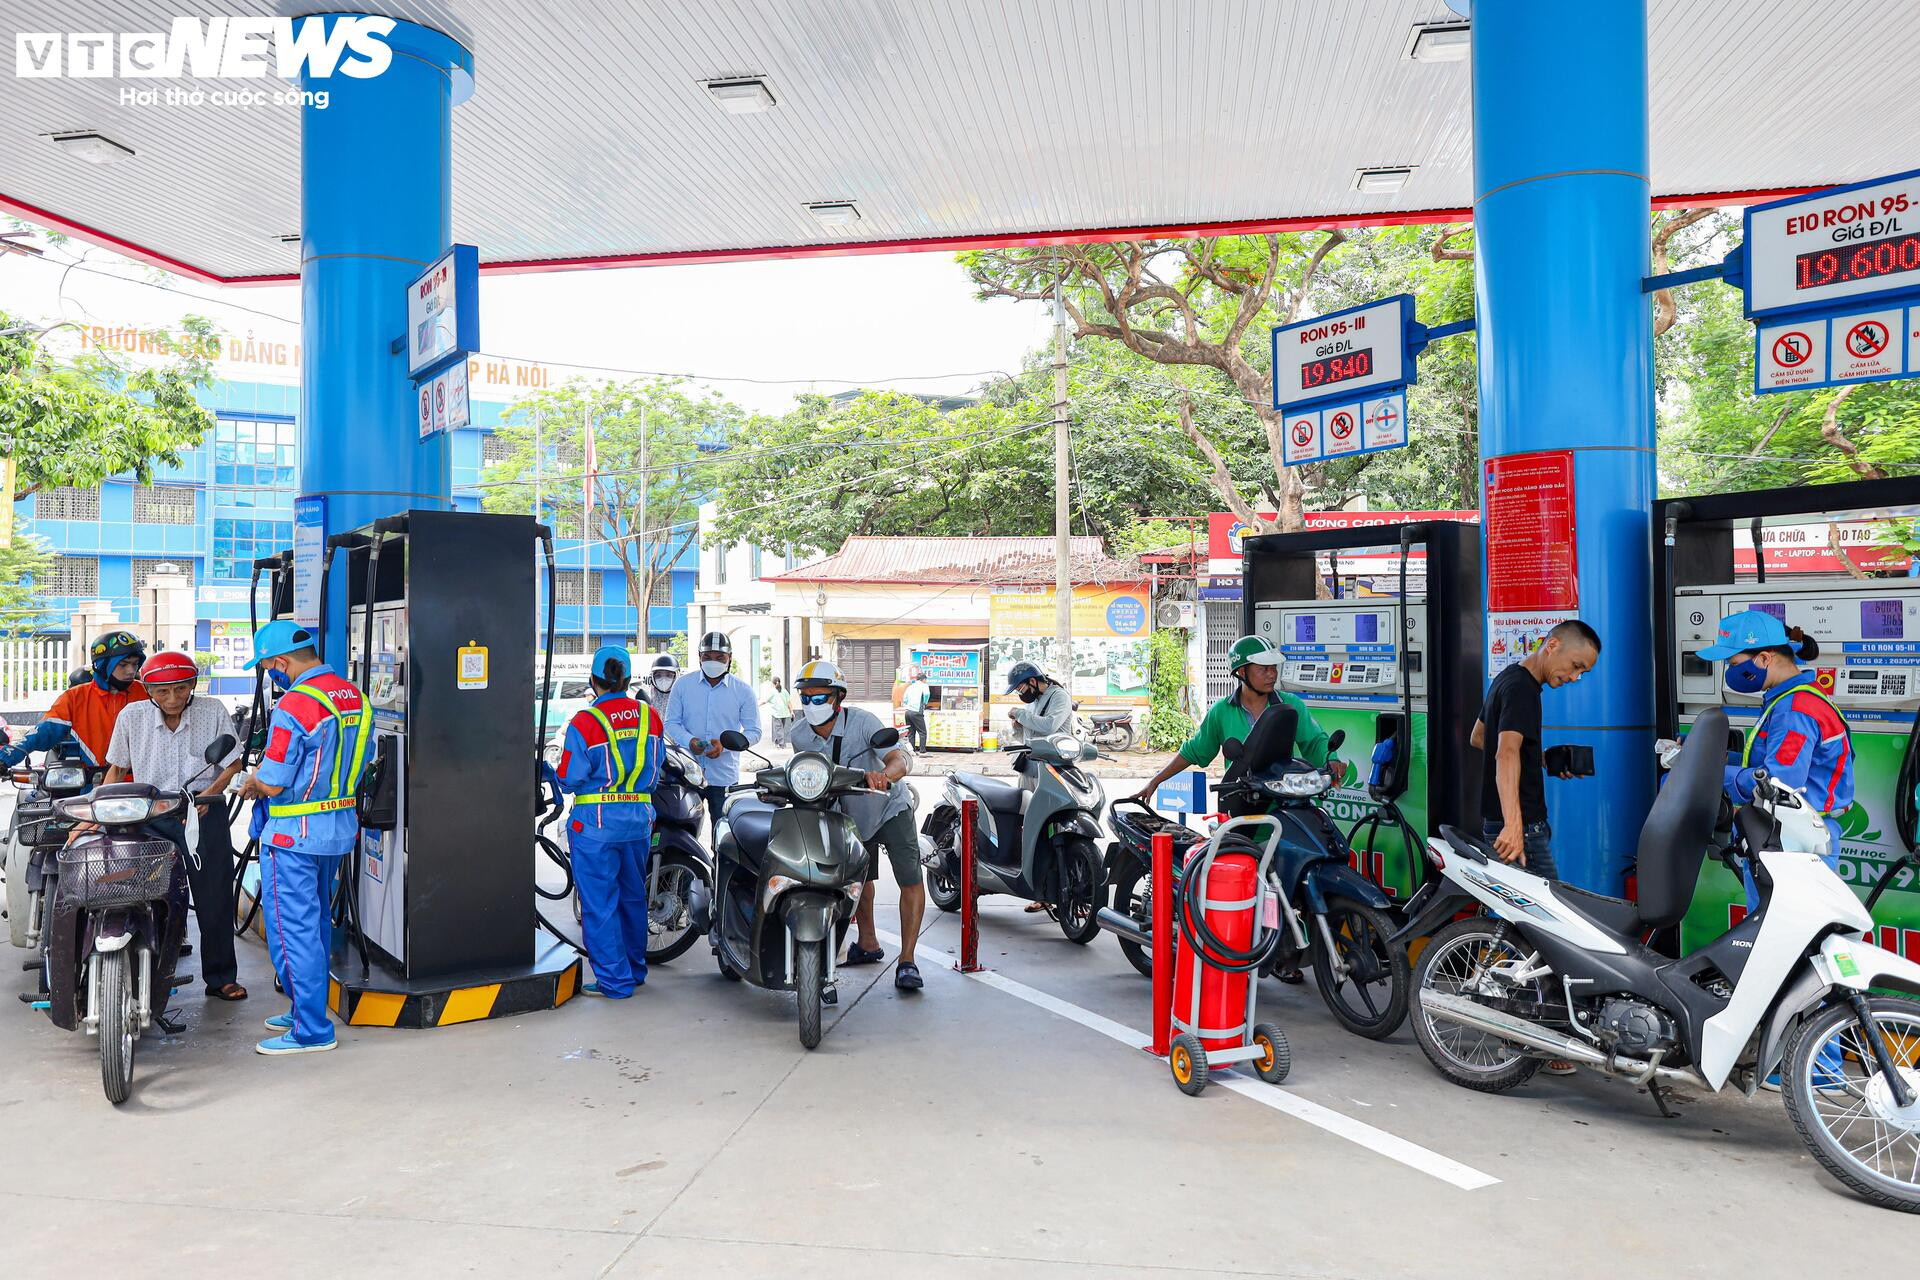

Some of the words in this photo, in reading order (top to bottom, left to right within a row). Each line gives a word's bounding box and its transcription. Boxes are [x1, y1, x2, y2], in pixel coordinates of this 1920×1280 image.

[1786, 212, 1819, 235] E10
[1823, 200, 1875, 228] RON
[1831, 222, 1865, 243] Giá
[1869, 217, 1903, 236] Đ/L
[1797, 237, 1920, 289] 19.600
[1300, 325, 1328, 345] RON
[229, 329, 288, 366] ĐẲNG
[1315, 342, 1334, 358] Giá
[1335, 339, 1353, 353] Đ/L
[487, 359, 510, 385] HÀ
[1302, 353, 1369, 388] 19.840
[1850, 361, 1866, 369] CẤM
[1838, 371, 1855, 379] CẤM
[1869, 367, 1892, 375] THUỐC
[1304, 518, 1348, 528] ƯỜNG
[1762, 530, 1776, 543] ỬA
[1779, 528, 1806, 543] CHỮA
[1852, 530, 1871, 543] TẠO
[1522, 617, 1543, 625] CHỮA
[328, 689, 358, 701] PVOIL
[611, 709, 640, 723] PVOIL
[320, 801, 336, 811] E10
[1841, 847, 1858, 856] NH
[1860, 849, 1887, 859] HỌC
